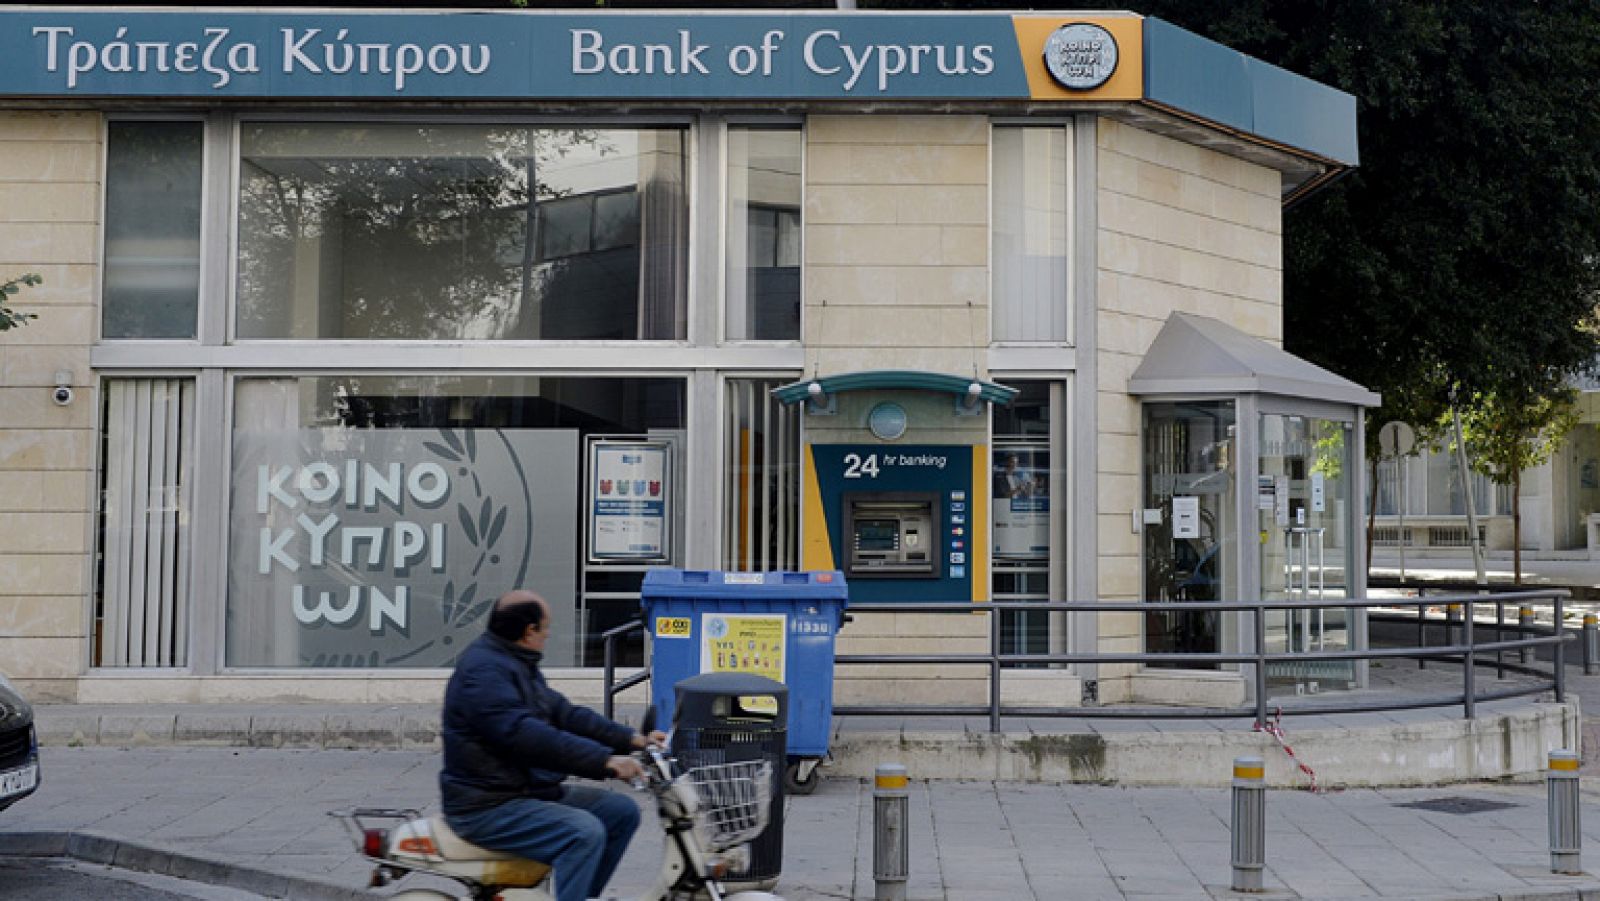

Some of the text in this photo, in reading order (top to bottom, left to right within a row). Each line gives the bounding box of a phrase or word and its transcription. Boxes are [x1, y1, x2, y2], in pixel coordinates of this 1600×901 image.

[32, 26, 491, 91] Τράπεζα Κύπρου
[569, 28, 995, 91] Bank of Cyprus
[843, 453, 947, 479] 24 hr banking
